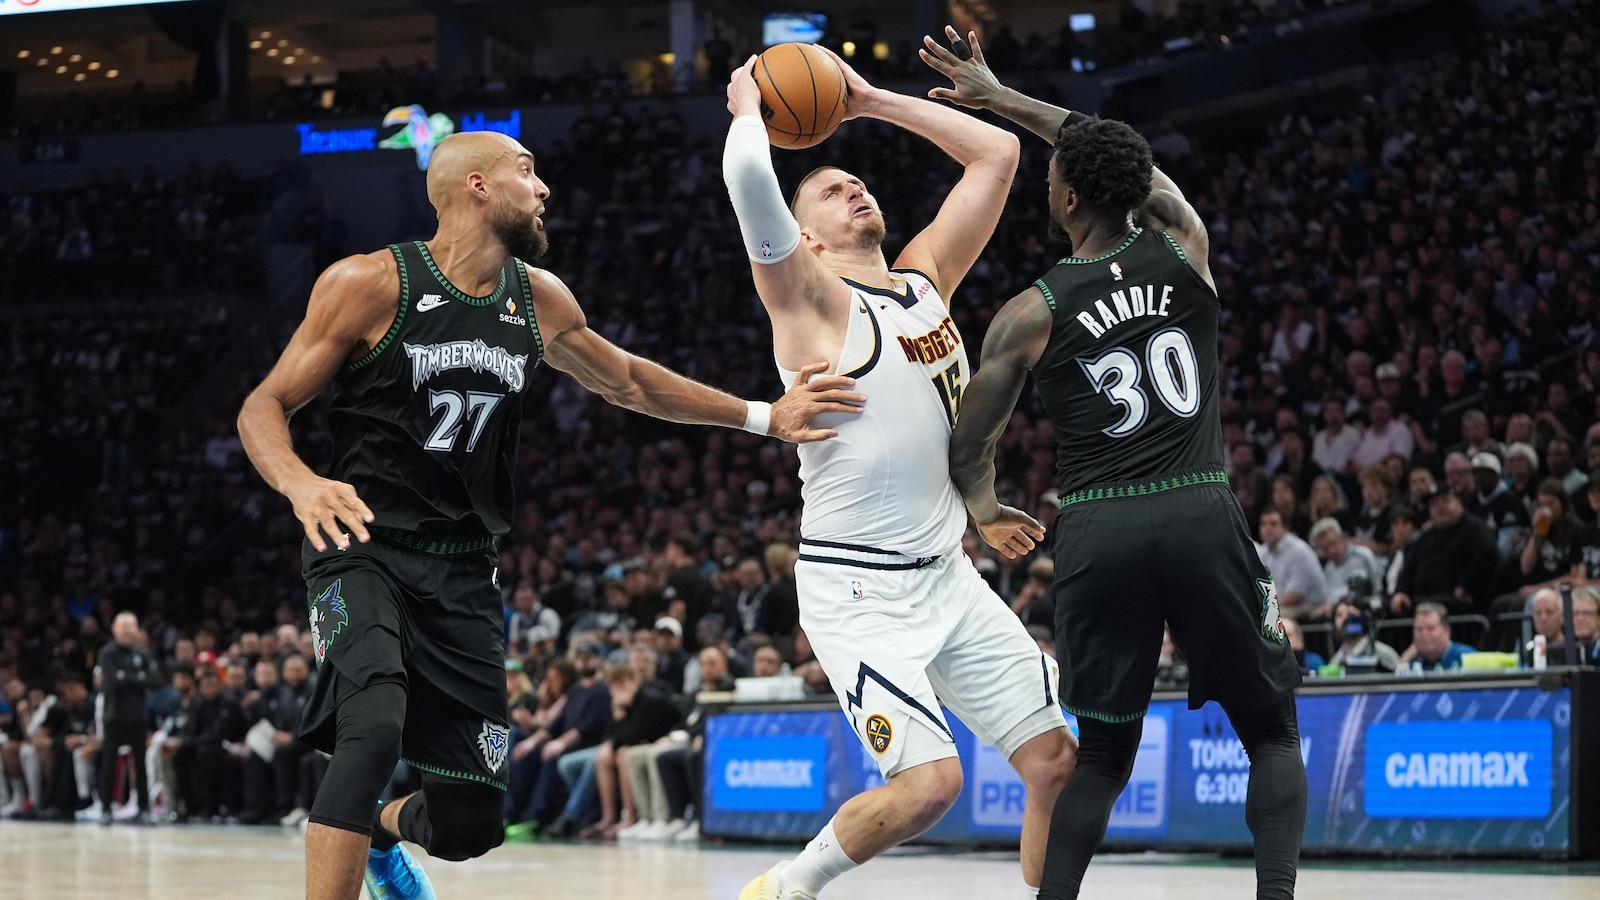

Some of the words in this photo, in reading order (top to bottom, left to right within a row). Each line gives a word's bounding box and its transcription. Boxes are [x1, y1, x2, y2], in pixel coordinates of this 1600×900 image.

[421, 293, 442, 305] NIKE
[499, 313, 526, 327] sezzle
[1076, 284, 1174, 339] RANDLE
[403, 338, 529, 393] TIMBERWOLVES
[1075, 327, 1200, 438] 30
[423, 388, 505, 453] 27
[931, 359, 962, 430] 15
